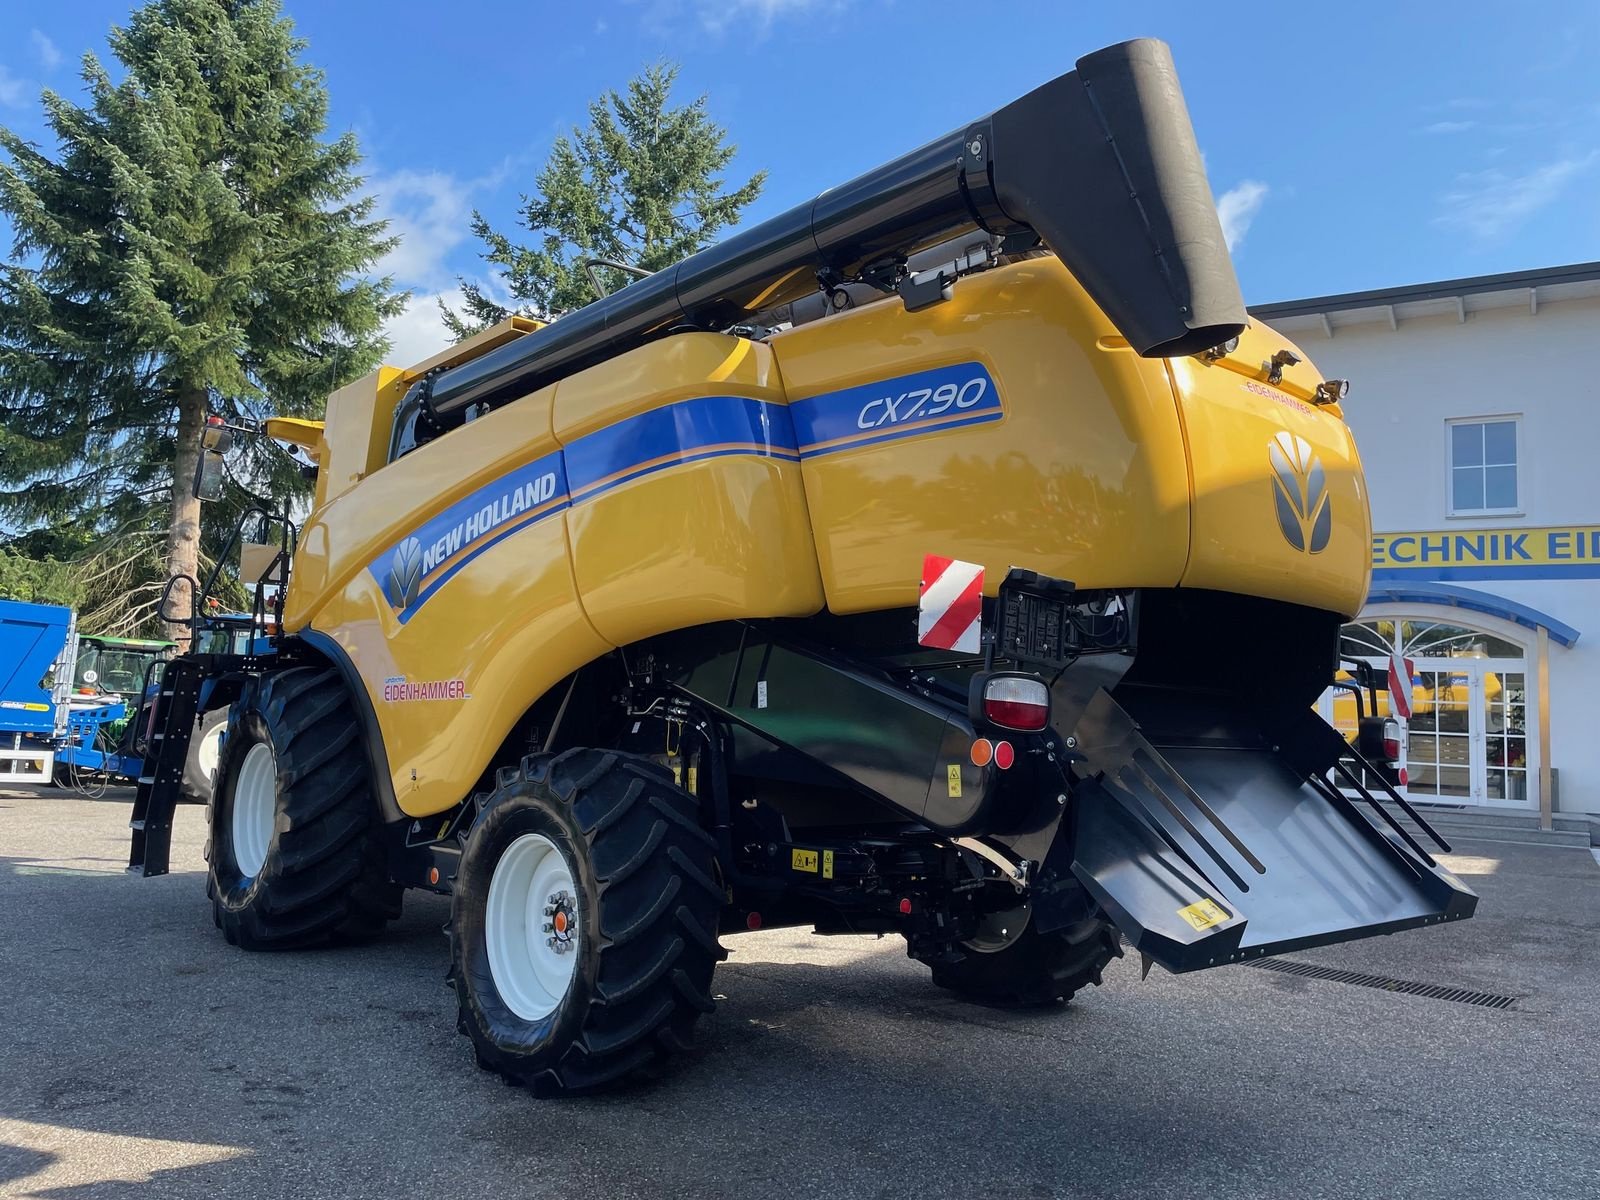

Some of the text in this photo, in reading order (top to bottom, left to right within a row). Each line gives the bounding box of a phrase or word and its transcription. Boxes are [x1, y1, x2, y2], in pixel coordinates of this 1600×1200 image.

[857, 377, 987, 429] CX7.90
[1246, 381, 1313, 416] EIDENHAMMER
[422, 472, 556, 576] NEW HOLLAND
[384, 680, 465, 702] EIDENHAMMER
